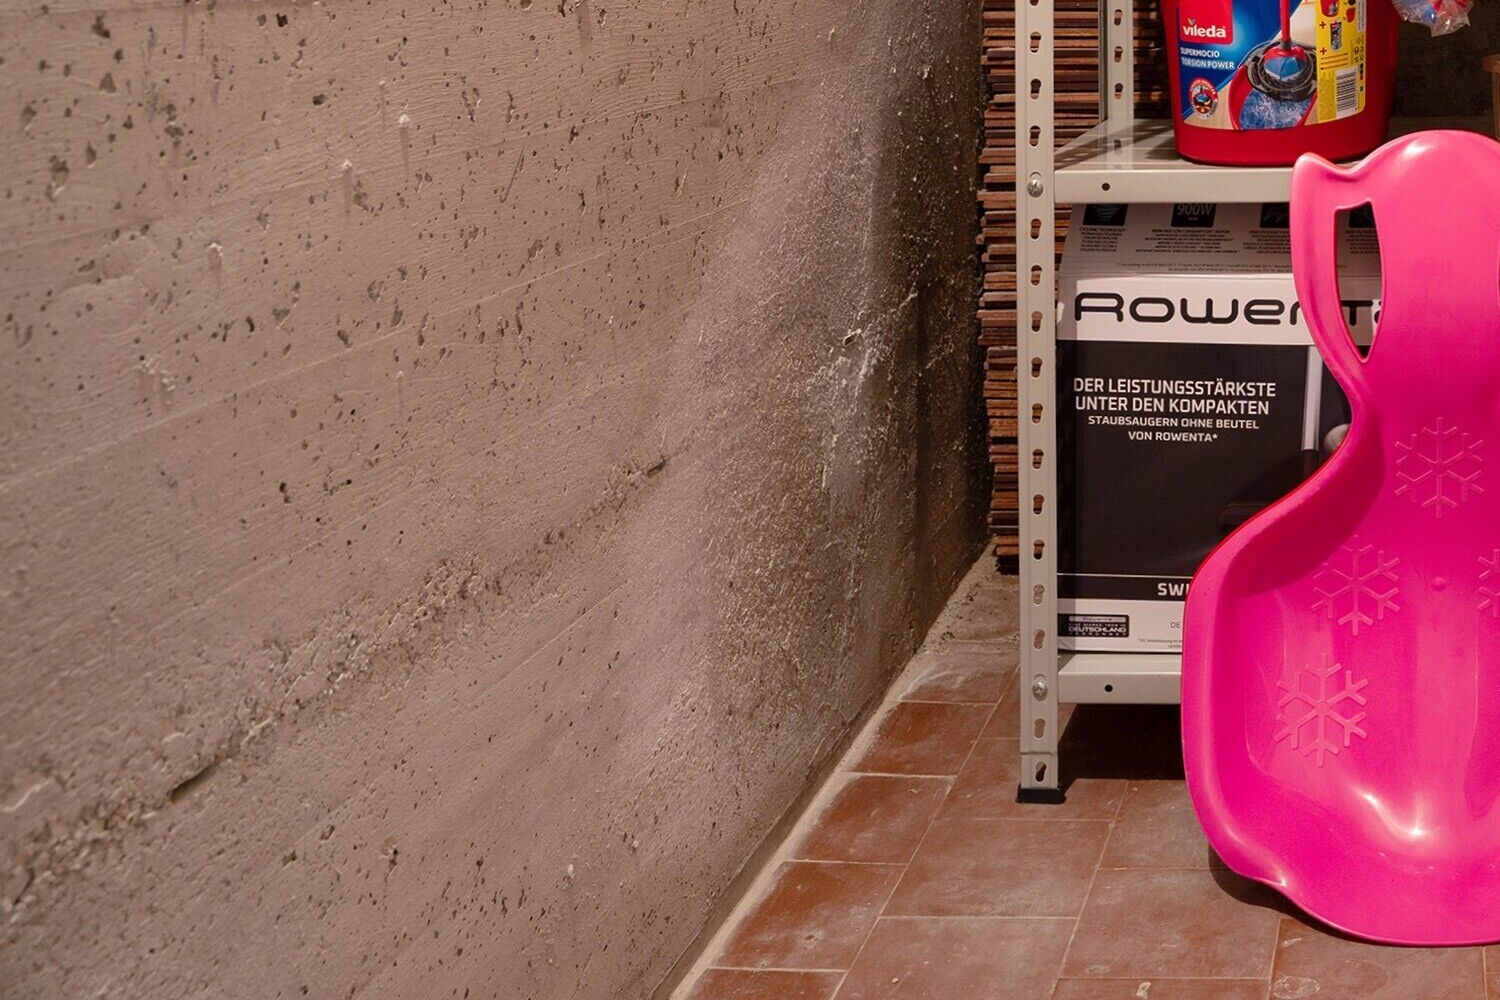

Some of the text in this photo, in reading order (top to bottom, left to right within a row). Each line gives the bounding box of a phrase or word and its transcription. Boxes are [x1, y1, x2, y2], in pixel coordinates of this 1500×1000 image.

[1182, 24, 1226, 38] vileda
[1207, 60, 1235, 70] POWER
[1073, 377, 1276, 397] DER LEISTUNGSSTÄRKSTE
[1075, 396, 1270, 415] UNTER DEN KOMPAKTEN
[1088, 415, 1260, 430] STAUBSAUGERN OHNE BEUTEL
[1128, 431, 1153, 441] VON
